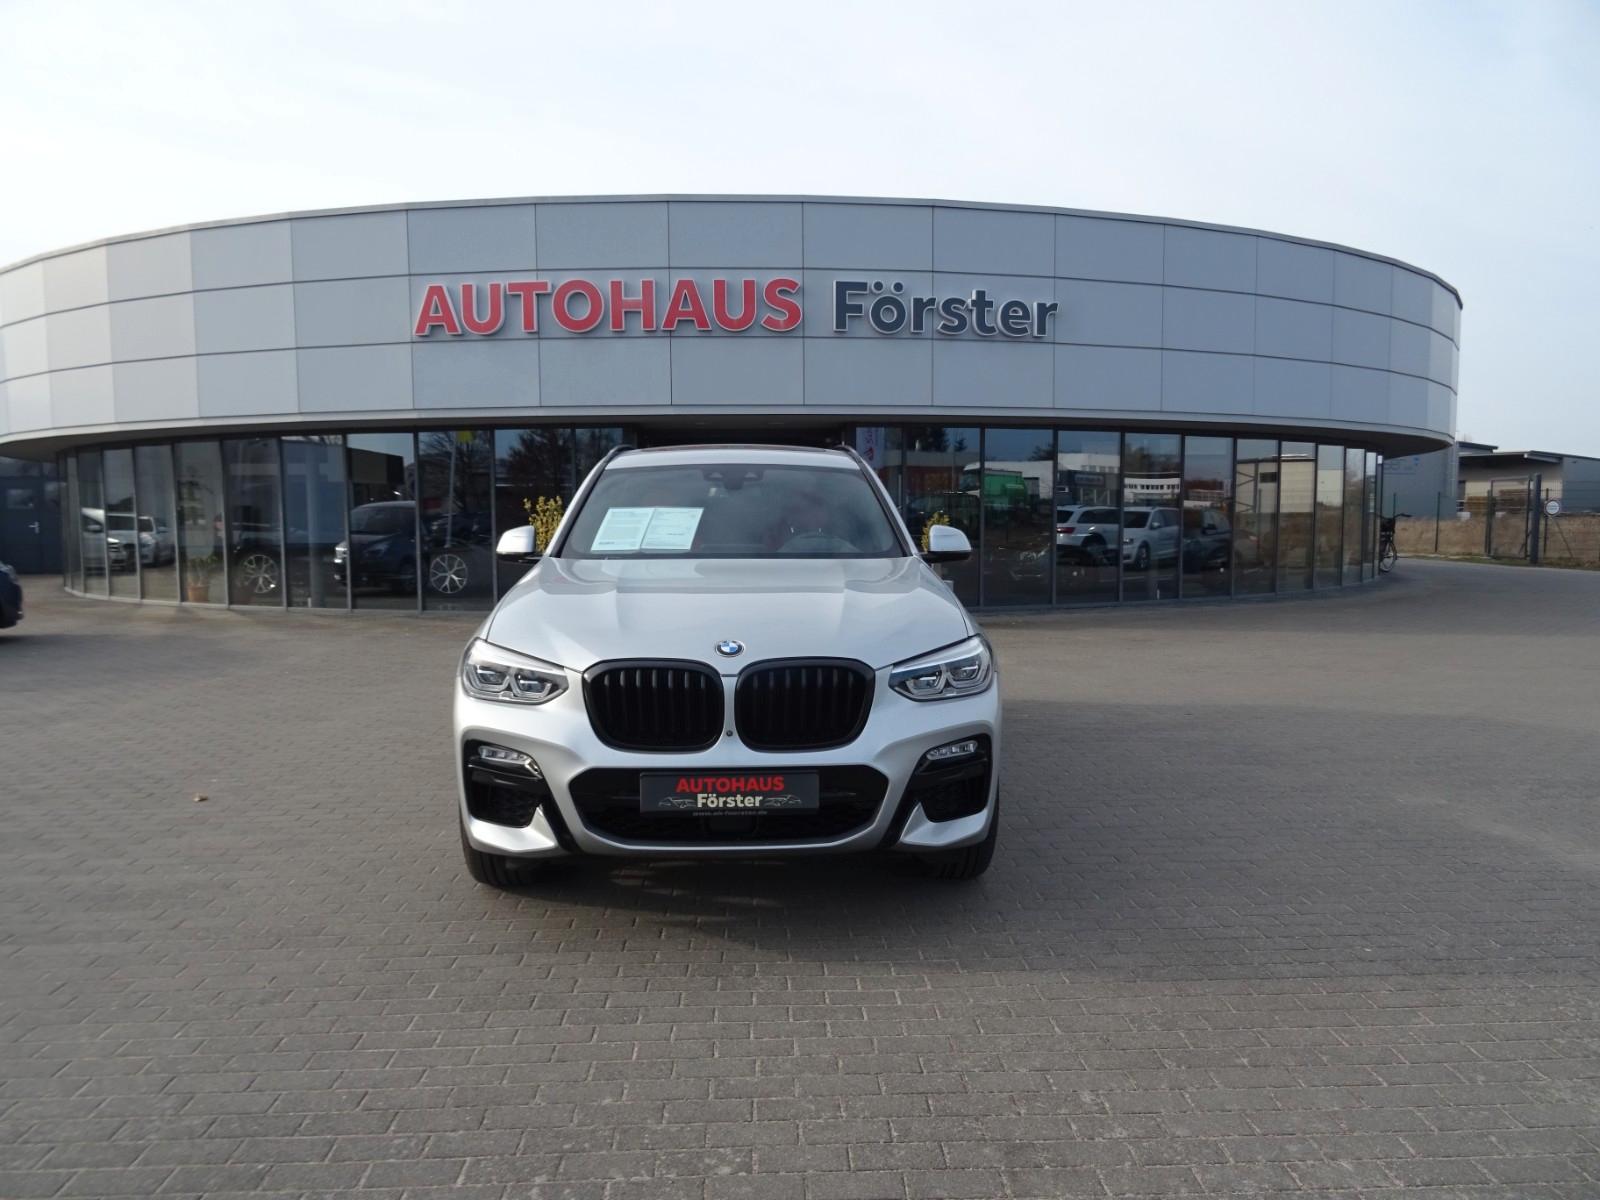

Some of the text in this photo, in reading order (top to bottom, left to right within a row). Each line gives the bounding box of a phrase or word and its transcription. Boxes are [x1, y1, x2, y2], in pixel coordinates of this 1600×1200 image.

[413, 277, 1058, 337] AUTOHAUS Förster
[676, 776, 785, 793] AUTOHAUS
[697, 793, 763, 808] Förster
